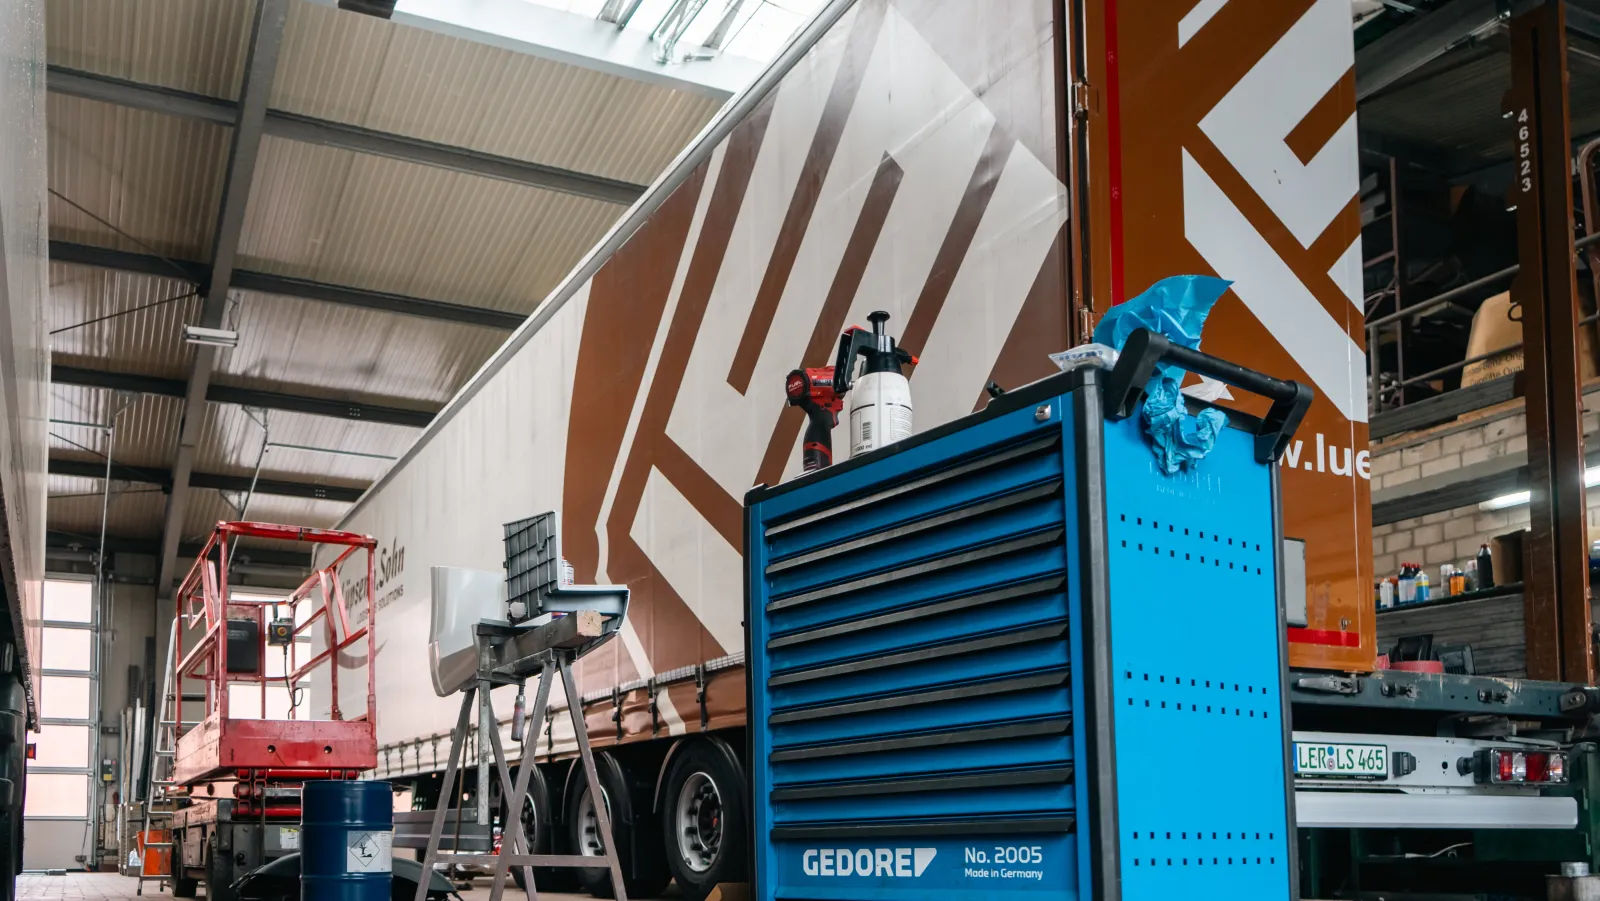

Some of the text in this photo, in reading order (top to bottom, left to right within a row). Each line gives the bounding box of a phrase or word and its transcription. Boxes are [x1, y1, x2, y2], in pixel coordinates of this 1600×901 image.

[1518, 108, 1532, 192] 46523
[378, 536, 405, 587] Sohn
[1299, 746, 1384, 770] LER LS 465
[803, 848, 912, 877] GEDORE
[964, 846, 1043, 864] No. 2005
[964, 868, 1043, 880] Made in Germany
